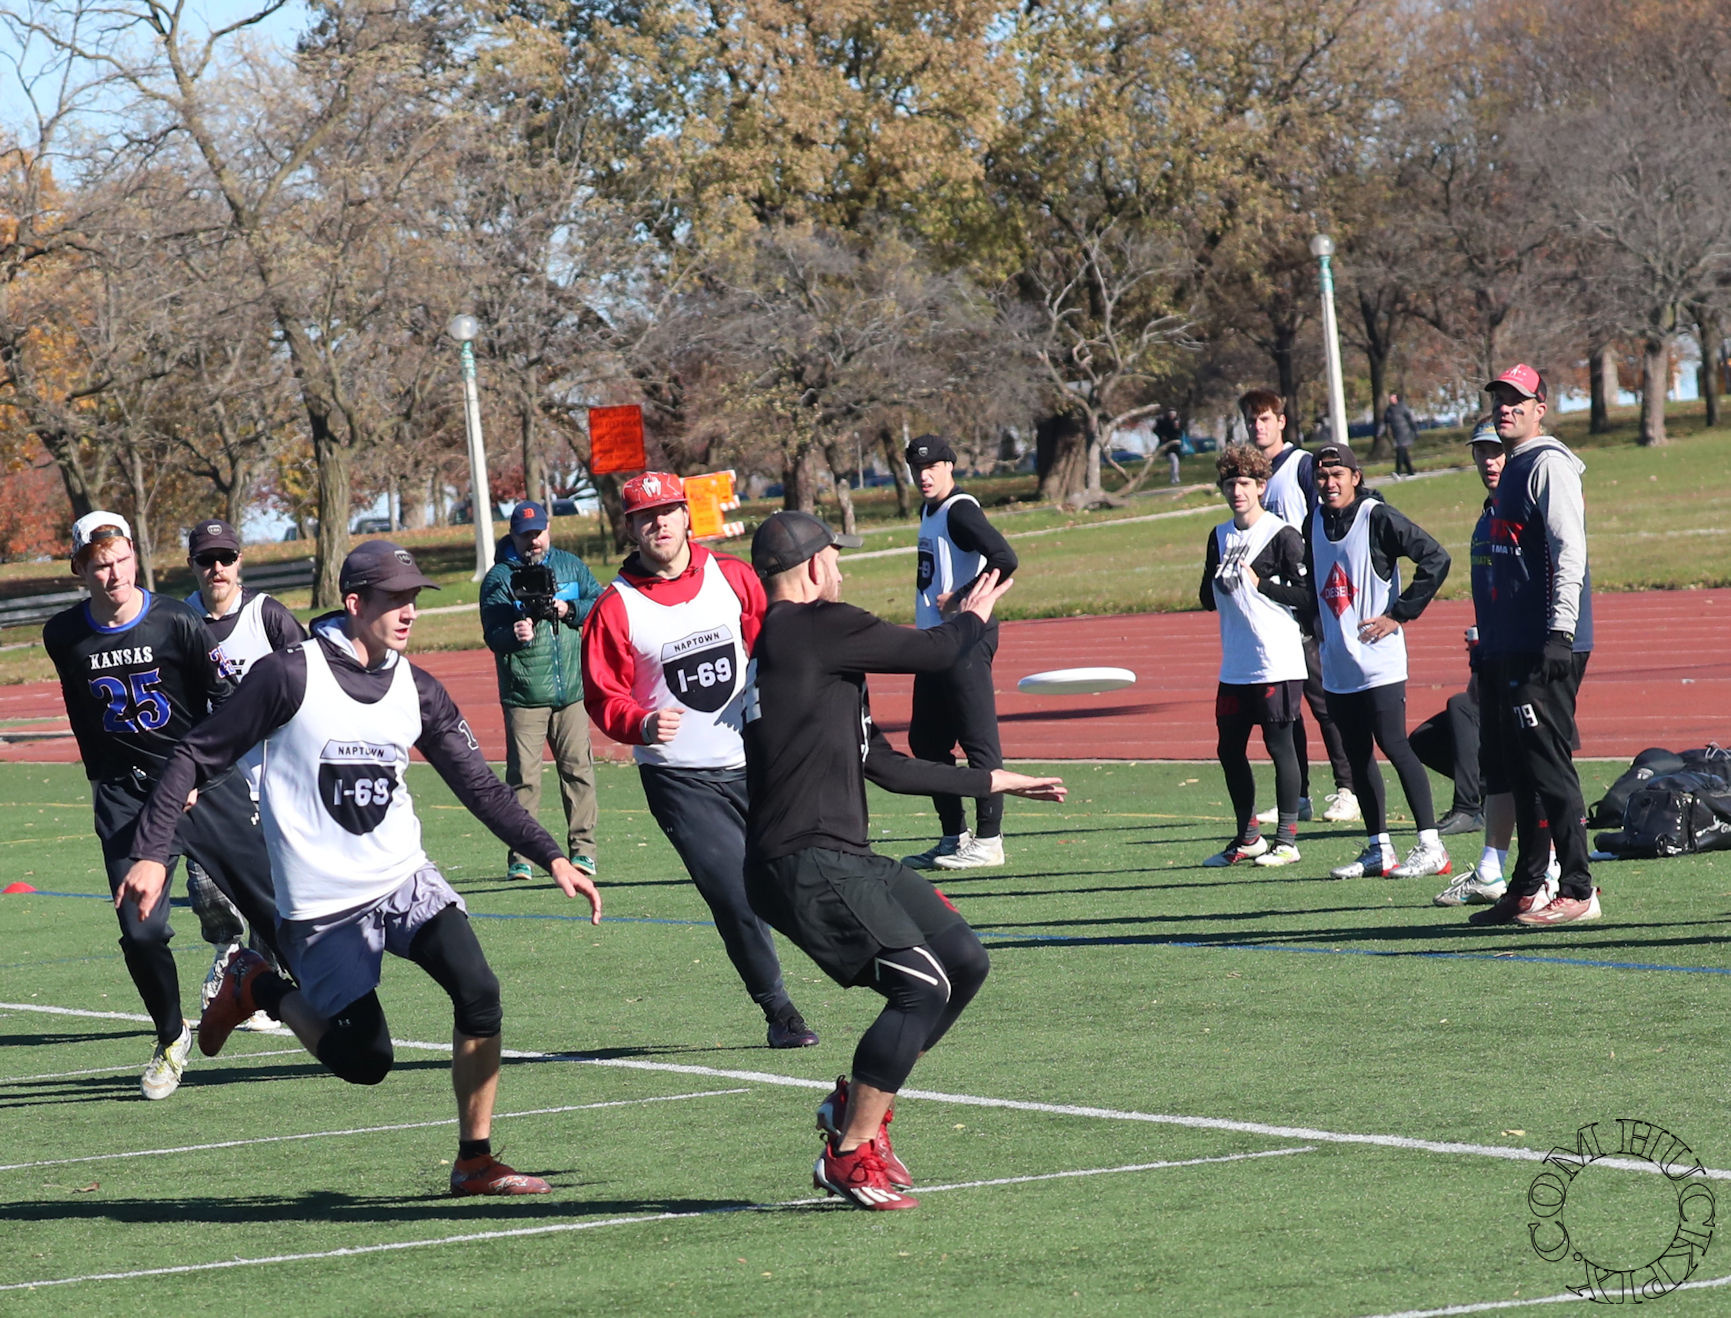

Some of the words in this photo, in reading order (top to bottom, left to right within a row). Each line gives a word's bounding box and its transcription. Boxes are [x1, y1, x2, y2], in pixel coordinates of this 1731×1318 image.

[674, 632, 720, 653] NAPTOWN
[89, 645, 154, 670] KANSAS
[677, 656, 732, 693] I-69
[88, 667, 172, 733] 25
[338, 745, 385, 759] NAPTOWN
[333, 777, 391, 807] I-69
